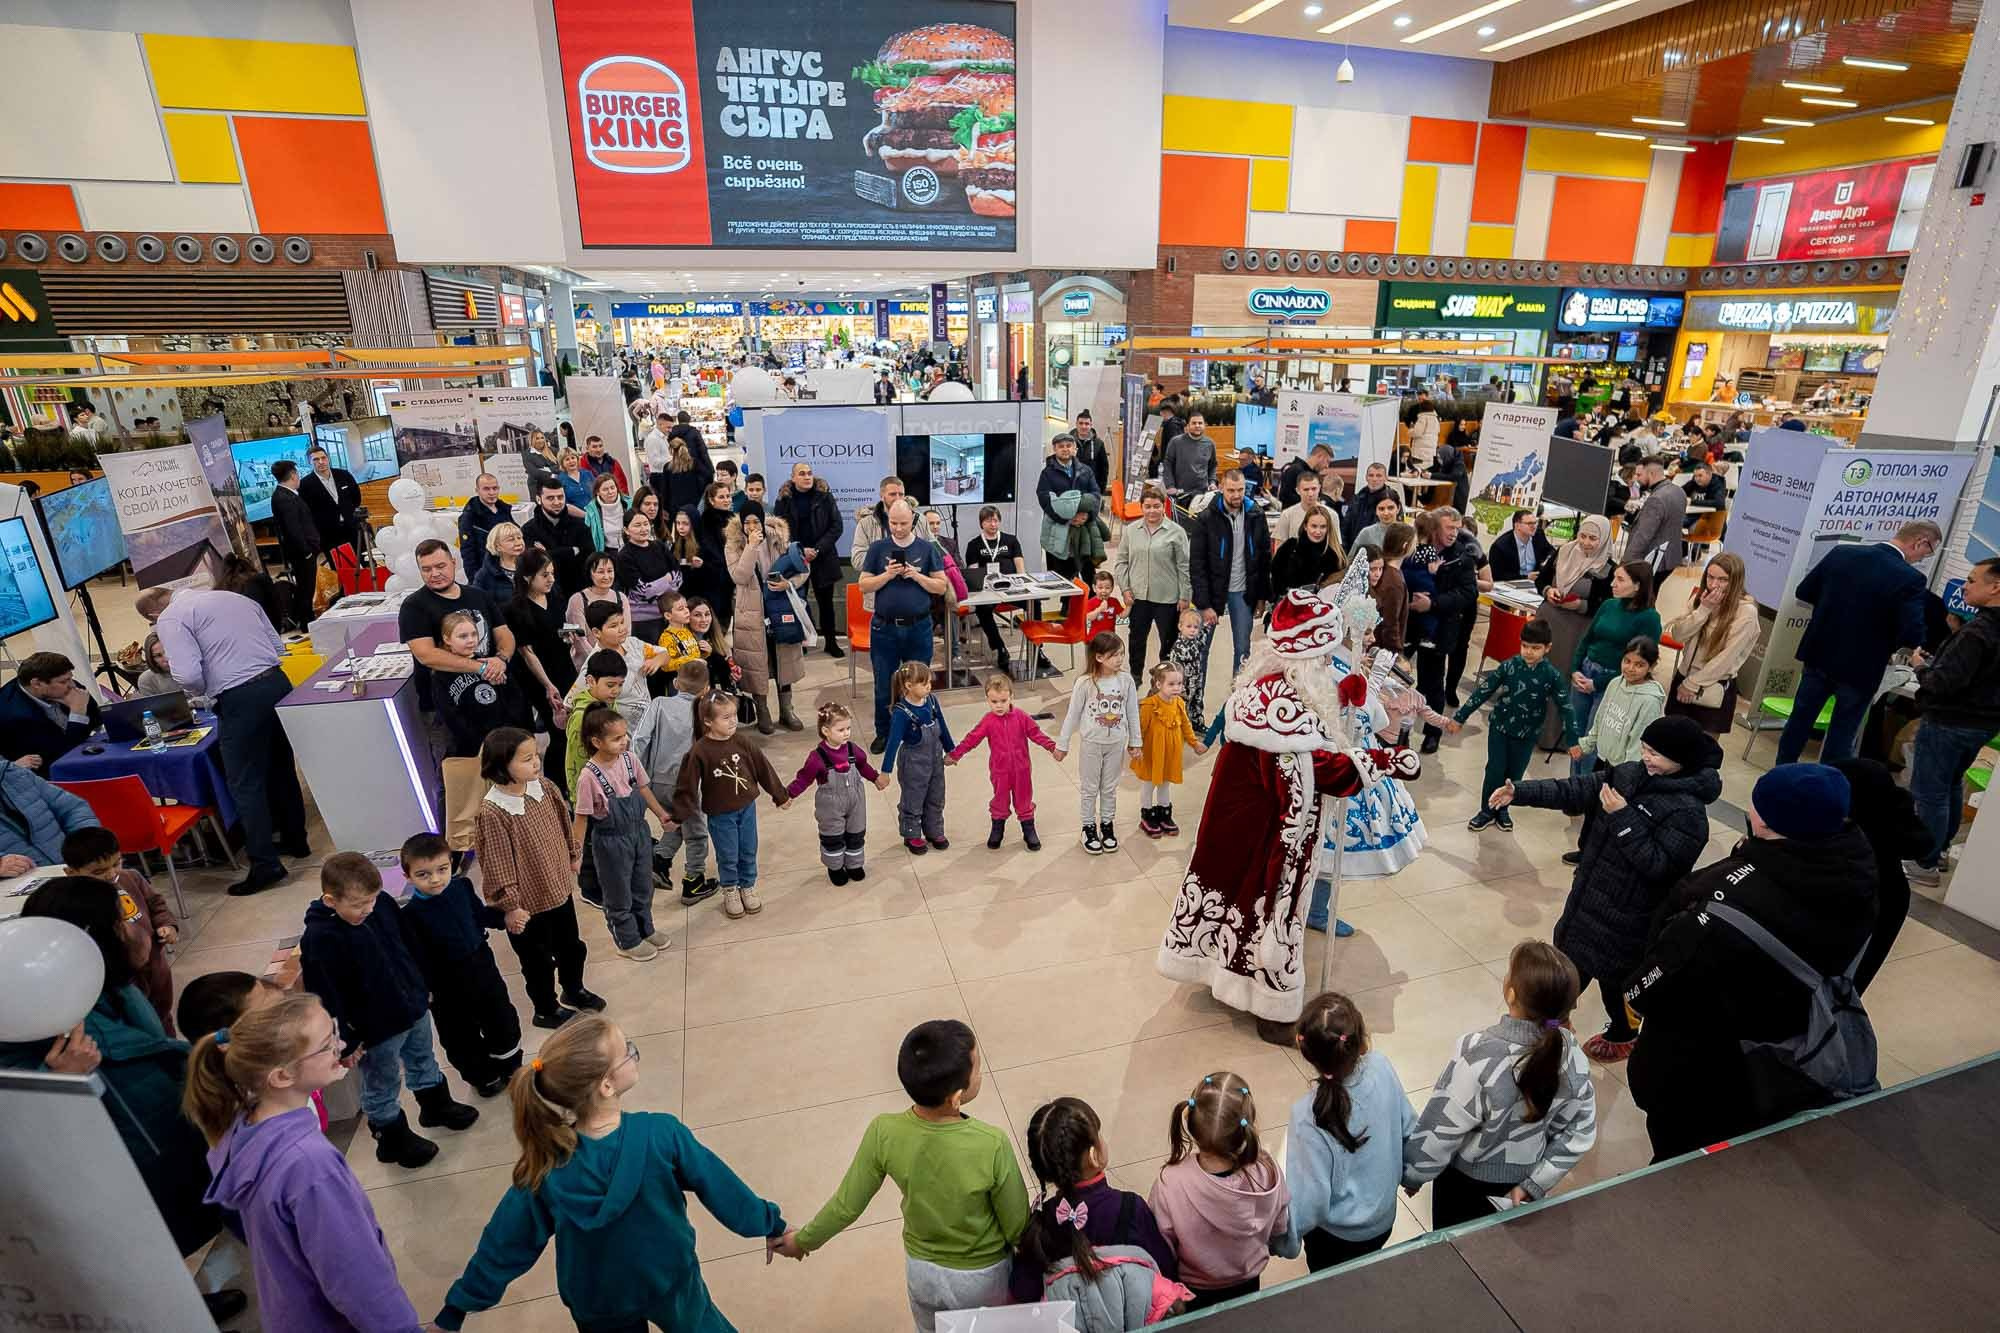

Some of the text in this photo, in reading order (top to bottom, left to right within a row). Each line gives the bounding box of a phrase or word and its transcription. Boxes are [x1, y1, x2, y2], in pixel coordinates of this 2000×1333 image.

[716, 46, 824, 78] АНГУС
[716, 75, 847, 106] ЧЕТЫРЕ
[585, 94, 682, 118] BURGER
[720, 104, 833, 140] СЫРА
[588, 116, 684, 149] KING
[722, 155, 803, 171] Всё очень
[724, 174, 806, 191] сырьёзно!
[912, 178, 929, 190] 150
[1809, 235, 1847, 246] СЕКТОР
[1253, 293, 1327, 310] CINNABON
[1441, 294, 1515, 320] SUBWAY
[1718, 302, 1773, 324] PIZZA
[1792, 302, 1856, 325] PIZZA
[1502, 413, 1547, 427] партнер
[779, 444, 875, 458] ИСТОРИЯ
[117, 475, 204, 500] КОГДА ХОЧЕТСЯ
[1785, 477, 1815, 494] земл
[122, 494, 190, 517] СВОЙ ДОМ
[1832, 490, 1939, 505] АВТОНОМНАЯ
[1823, 503, 1941, 519] КАНАЛИЗАЦИЯ
[1819, 519, 1863, 531] ТОПАС
[1878, 520, 1902, 531] ТОП
